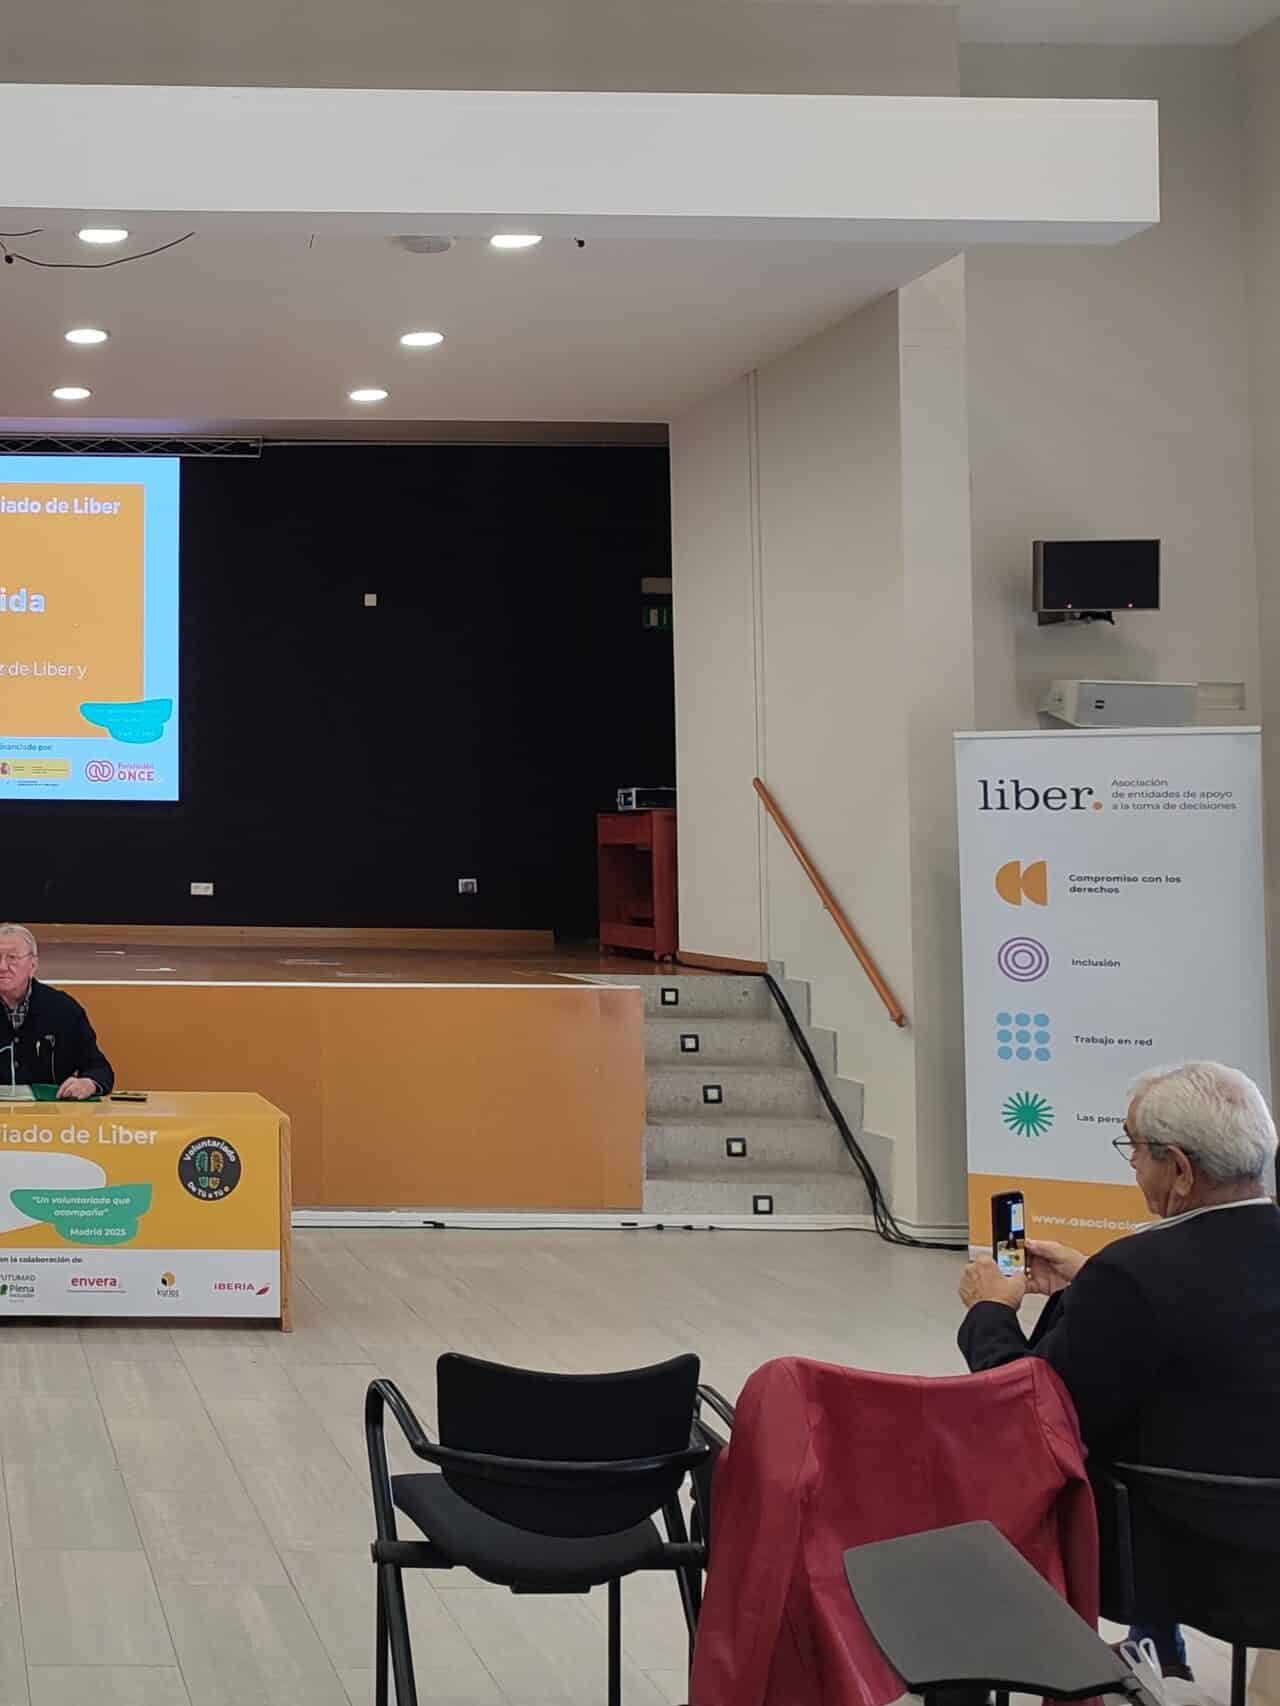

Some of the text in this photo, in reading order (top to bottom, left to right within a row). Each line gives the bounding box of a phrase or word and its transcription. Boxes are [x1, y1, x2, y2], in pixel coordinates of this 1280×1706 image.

[45, 497, 70, 515] de
[74, 497, 121, 515] Liber
[8, 661, 30, 677] de
[33, 661, 73, 677] Liber
[76, 665, 88, 681] y
[118, 770, 155, 781] ONCE
[1111, 777, 1168, 787] Asociación
[1111, 789, 1233, 801] de entidades de apoyo
[1120, 800, 1129, 810] la
[1132, 801, 1159, 810] toma
[1162, 800, 1176, 810] de
[1178, 800, 1237, 810] decisiones
[1069, 874, 1138, 885] Compromiso
[1165, 875, 1182, 884] los
[1069, 885, 1120, 894] derechos
[1073, 1035, 1114, 1046] Trabajo
[1134, 1037, 1153, 1046] red
[1076, 1113, 1095, 1122] Las
[60, 1125, 89, 1144] de
[98, 1126, 158, 1145] Liber
[183, 1139, 236, 1162] Voluntariado
[70, 1227, 102, 1236] Madrid
[71, 1277, 117, 1287] envera
[214, 1283, 255, 1291] IBERIA
[9, 1284, 35, 1293] Plena
